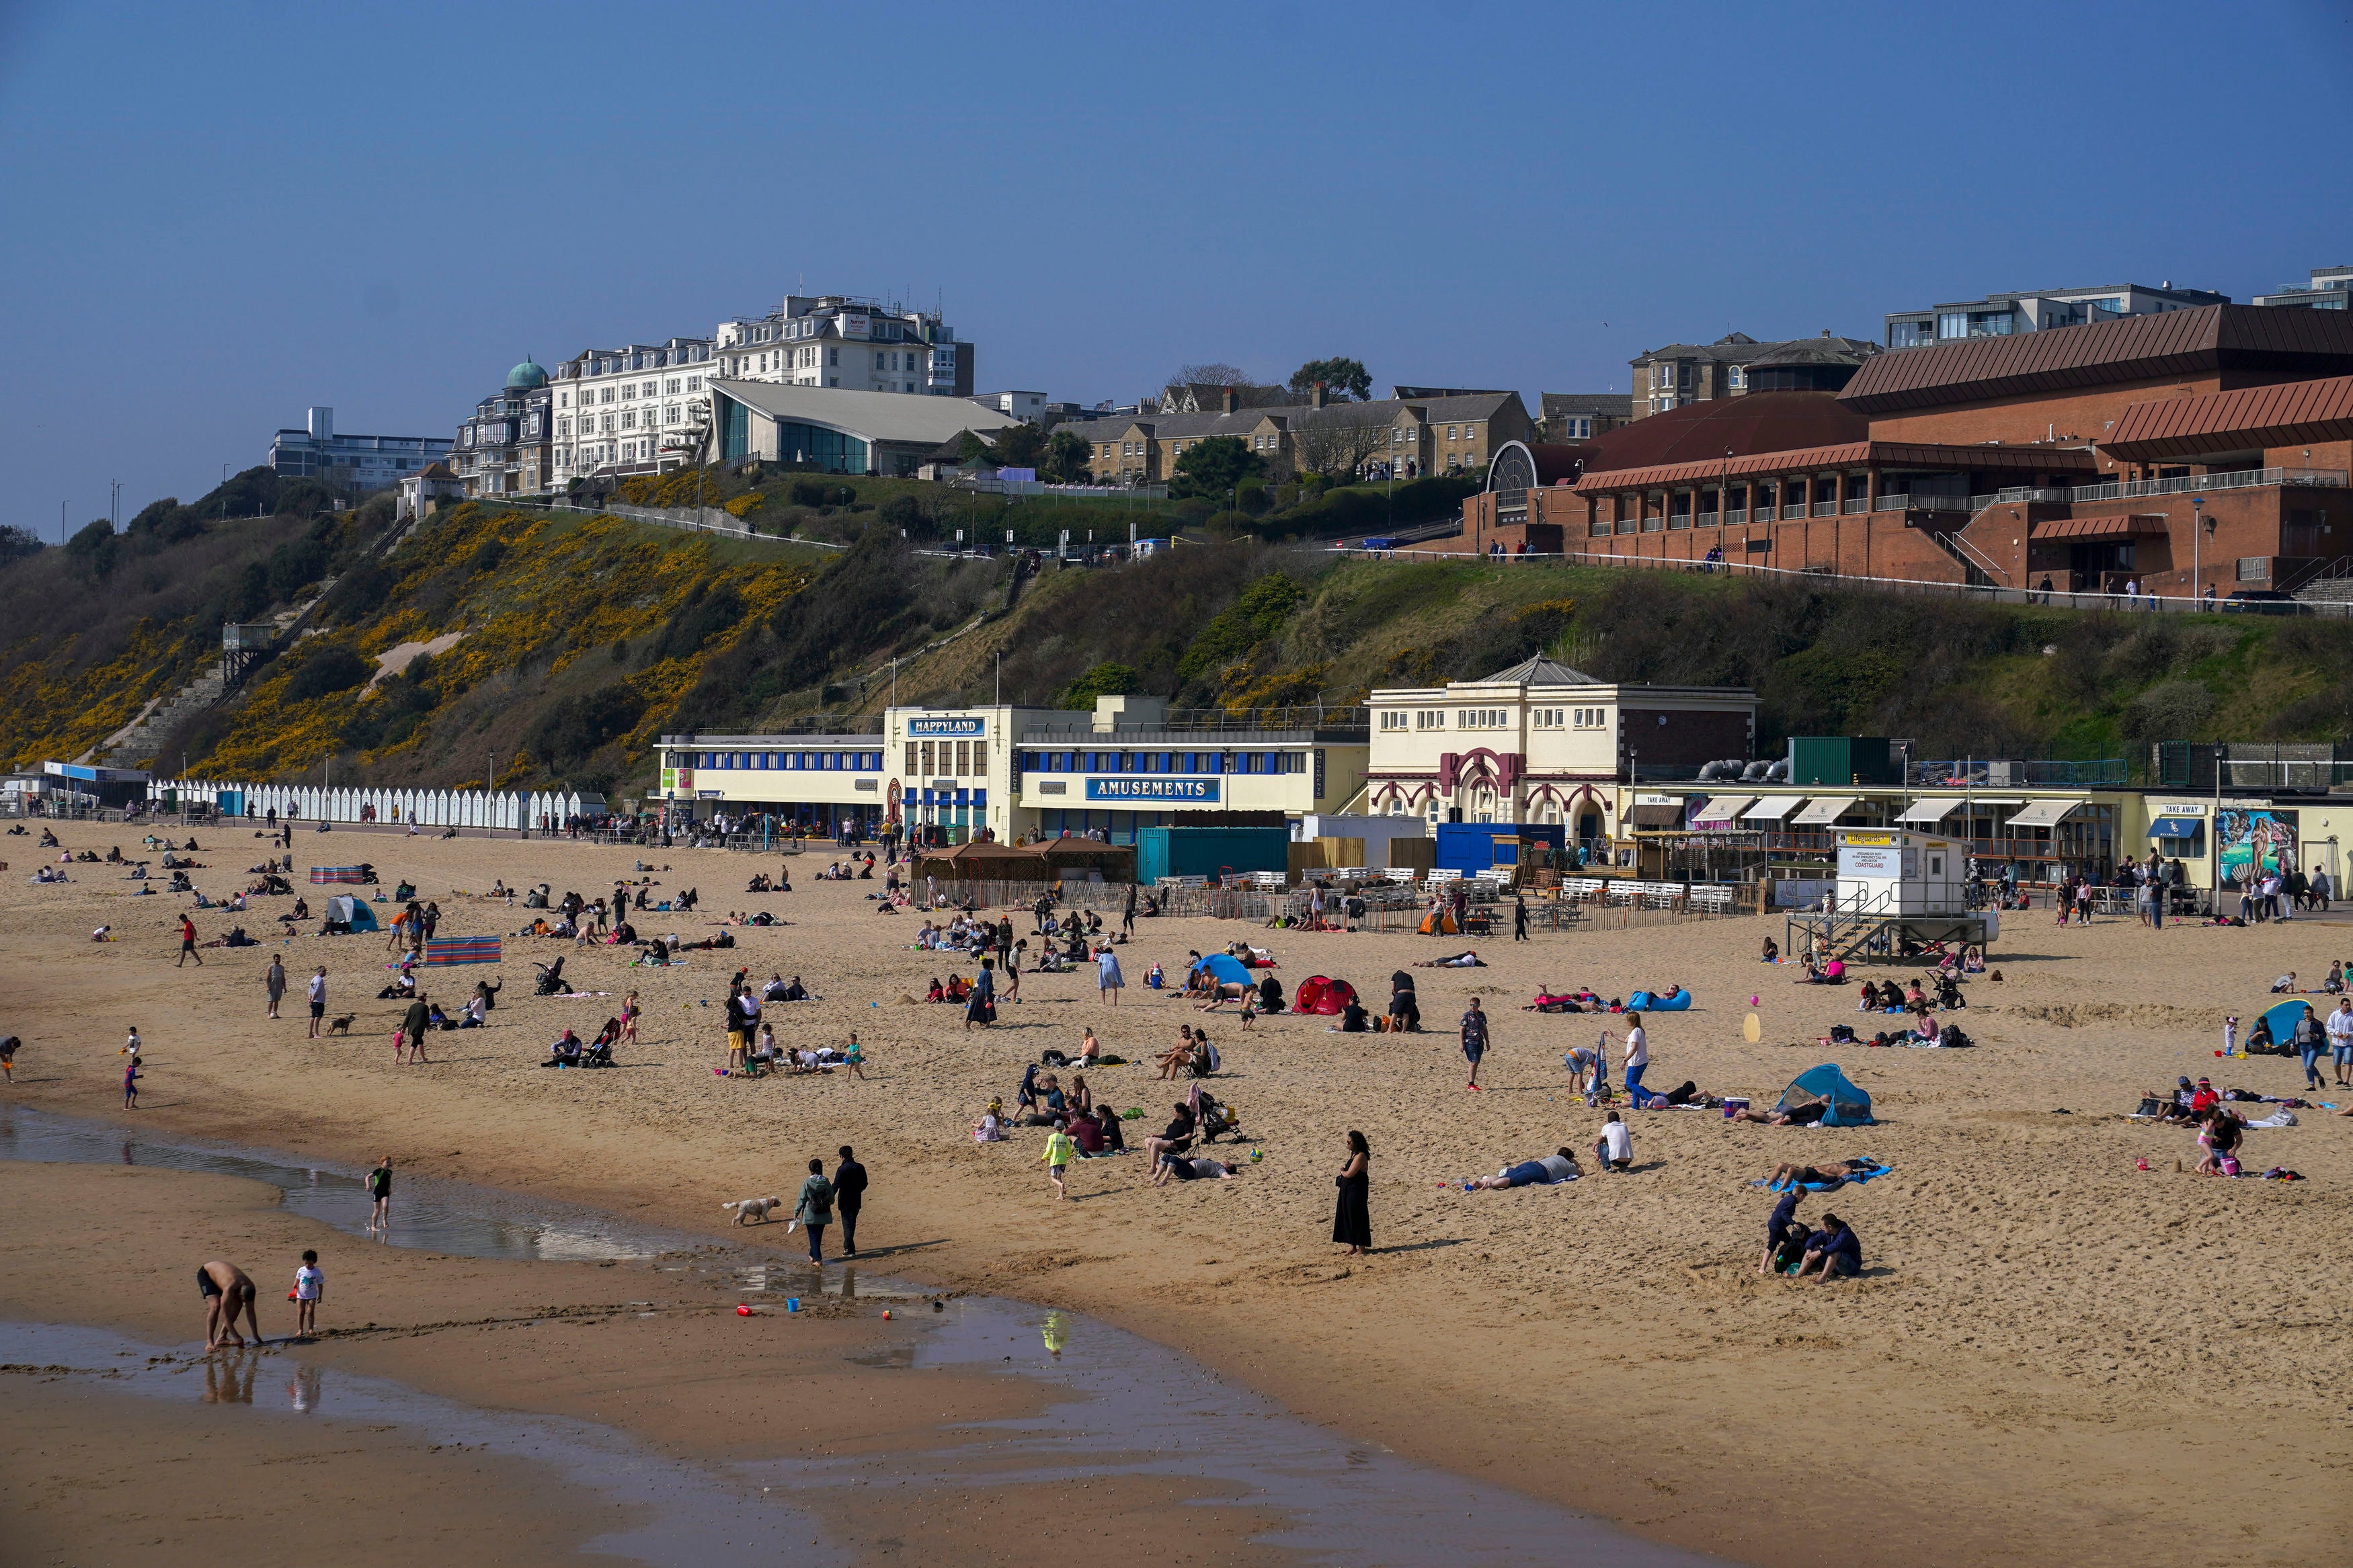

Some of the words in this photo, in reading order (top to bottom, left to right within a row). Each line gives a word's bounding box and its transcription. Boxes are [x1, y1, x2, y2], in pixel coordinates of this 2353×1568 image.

[916, 721, 975, 732] HAPPYLAND
[1097, 781, 1205, 796] AMUSEMENTS
[1851, 833, 1880, 844] Lifeguards
